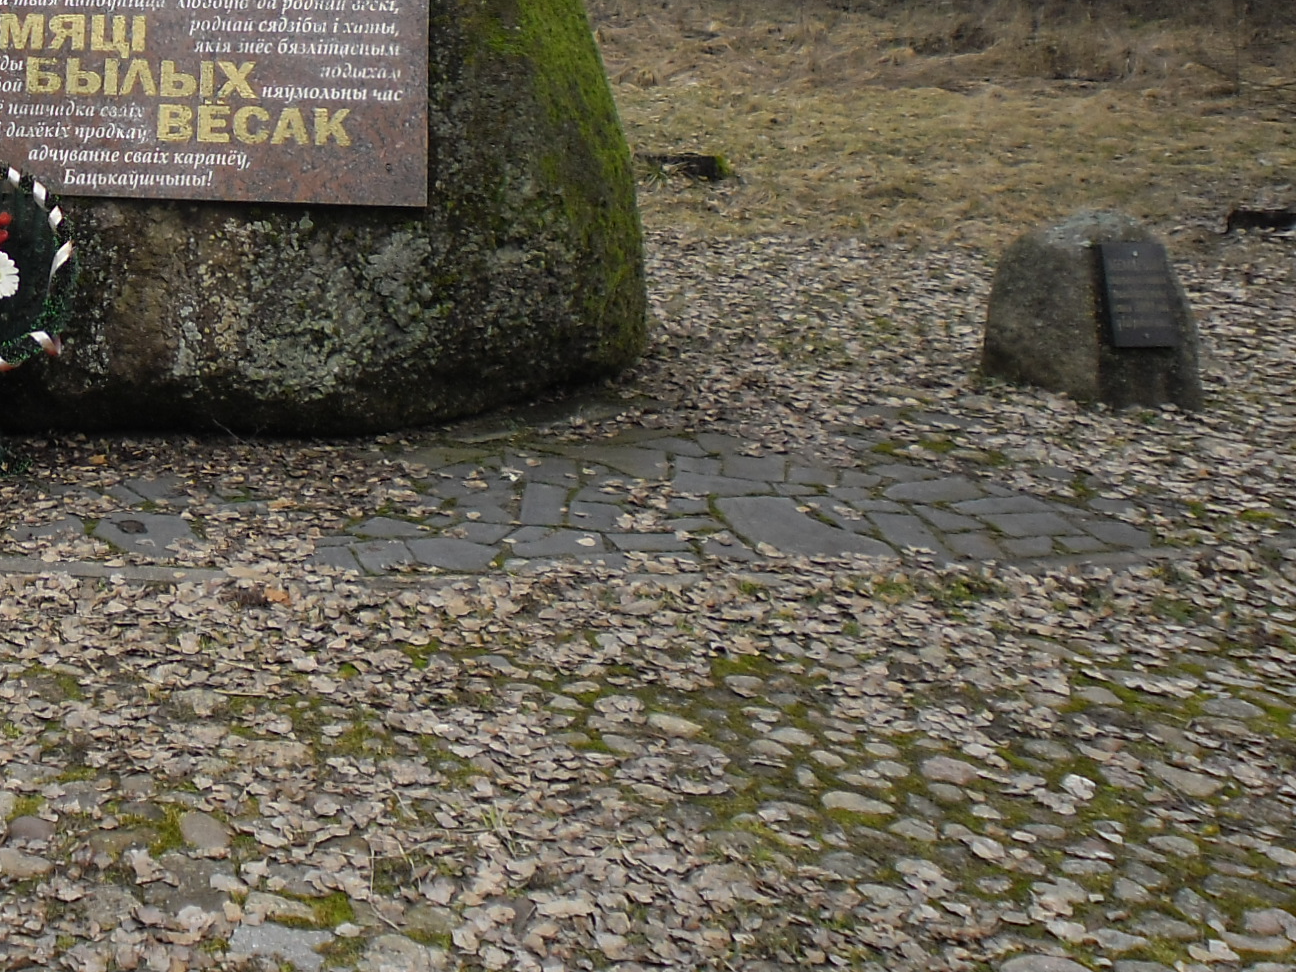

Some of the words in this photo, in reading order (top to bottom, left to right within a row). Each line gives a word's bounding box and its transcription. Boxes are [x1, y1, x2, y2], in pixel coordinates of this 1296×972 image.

[258, 16, 327, 34] сядзібы
[332, 17, 339, 34] і
[194, 38, 231, 54] якія
[237, 38, 272, 54] знёс
[25, 56, 258, 99] БЫЛЫХ
[262, 84, 367, 103] няўмольны
[372, 89, 404, 102] час
[6, 121, 71, 139] далёкіх
[157, 99, 352, 146] ВЁСАК
[28, 145, 119, 165] адчуванне
[123, 146, 171, 165] сваіх
[173, 149, 252, 170] каранёў,
[63, 167, 214, 191] Бацькаўшчыны!
